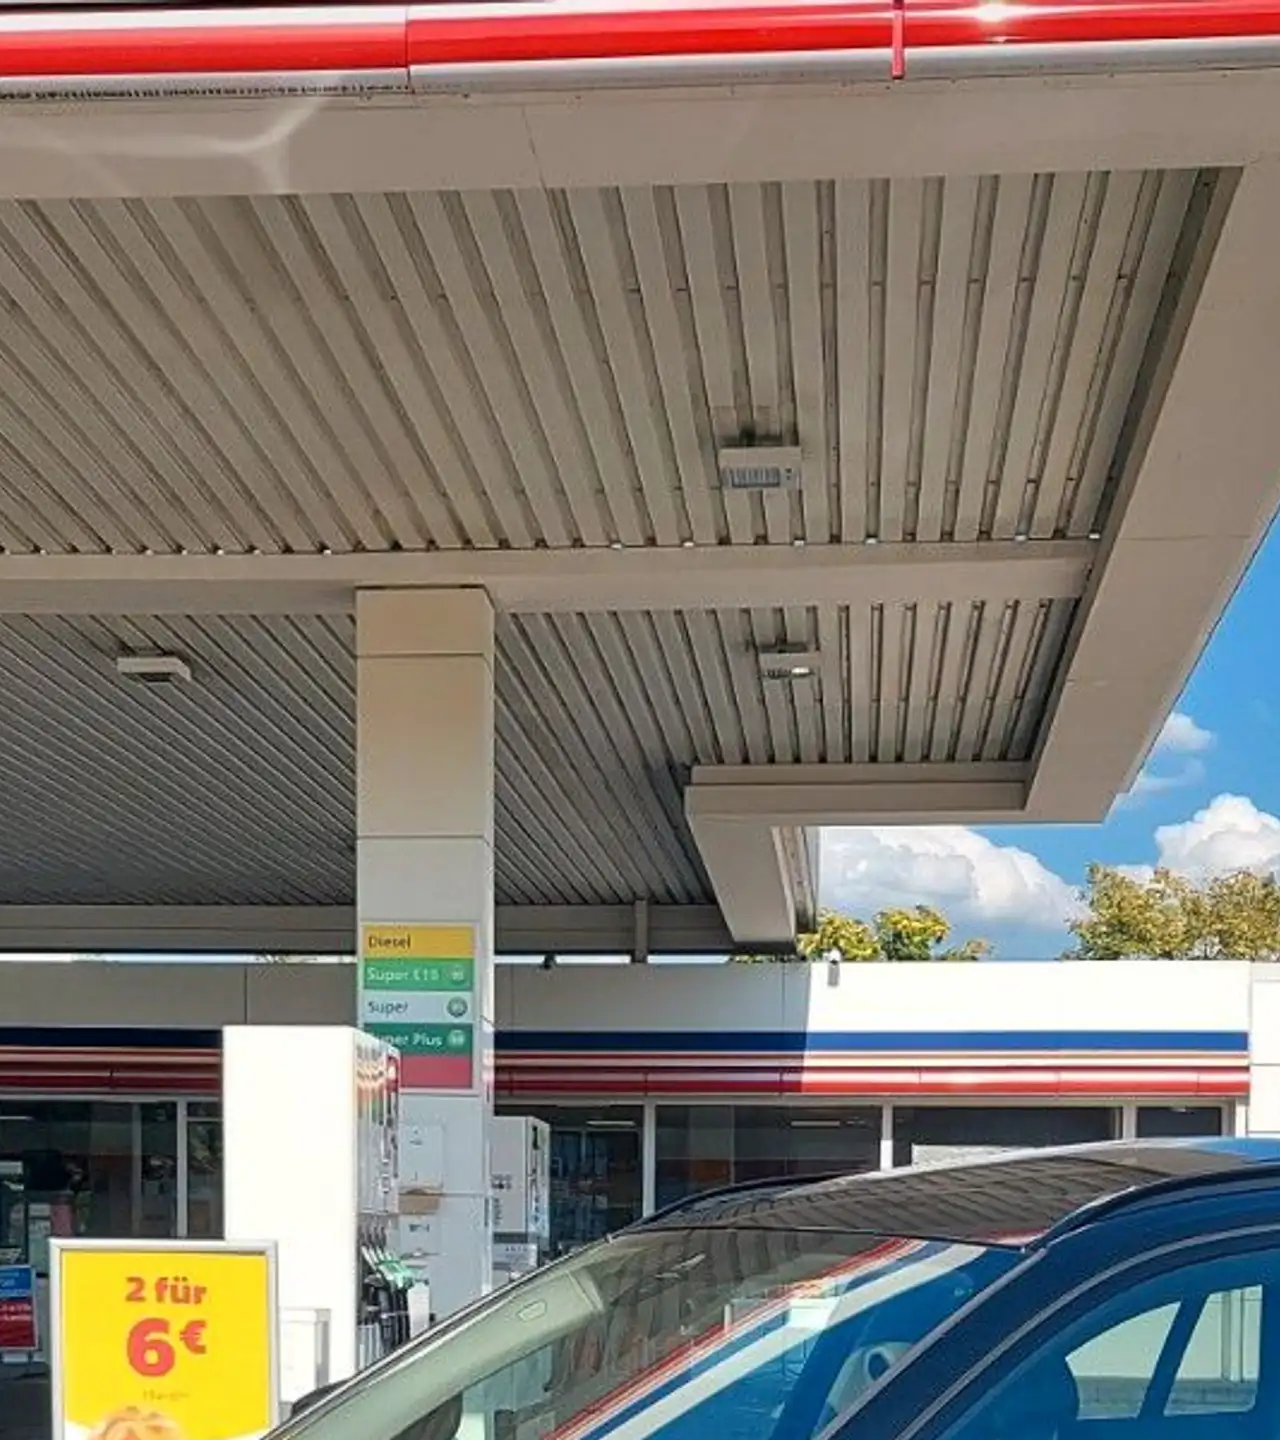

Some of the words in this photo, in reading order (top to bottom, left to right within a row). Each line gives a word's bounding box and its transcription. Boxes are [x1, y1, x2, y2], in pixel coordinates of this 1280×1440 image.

[368, 933, 411, 949] Diesel
[367, 966, 409, 983] Super
[368, 1001, 408, 1015] Super
[412, 1031, 442, 1047] Plus
[125, 1276, 146, 1303] 2
[154, 1275, 207, 1305] für
[126, 1317, 207, 1377] 6€
